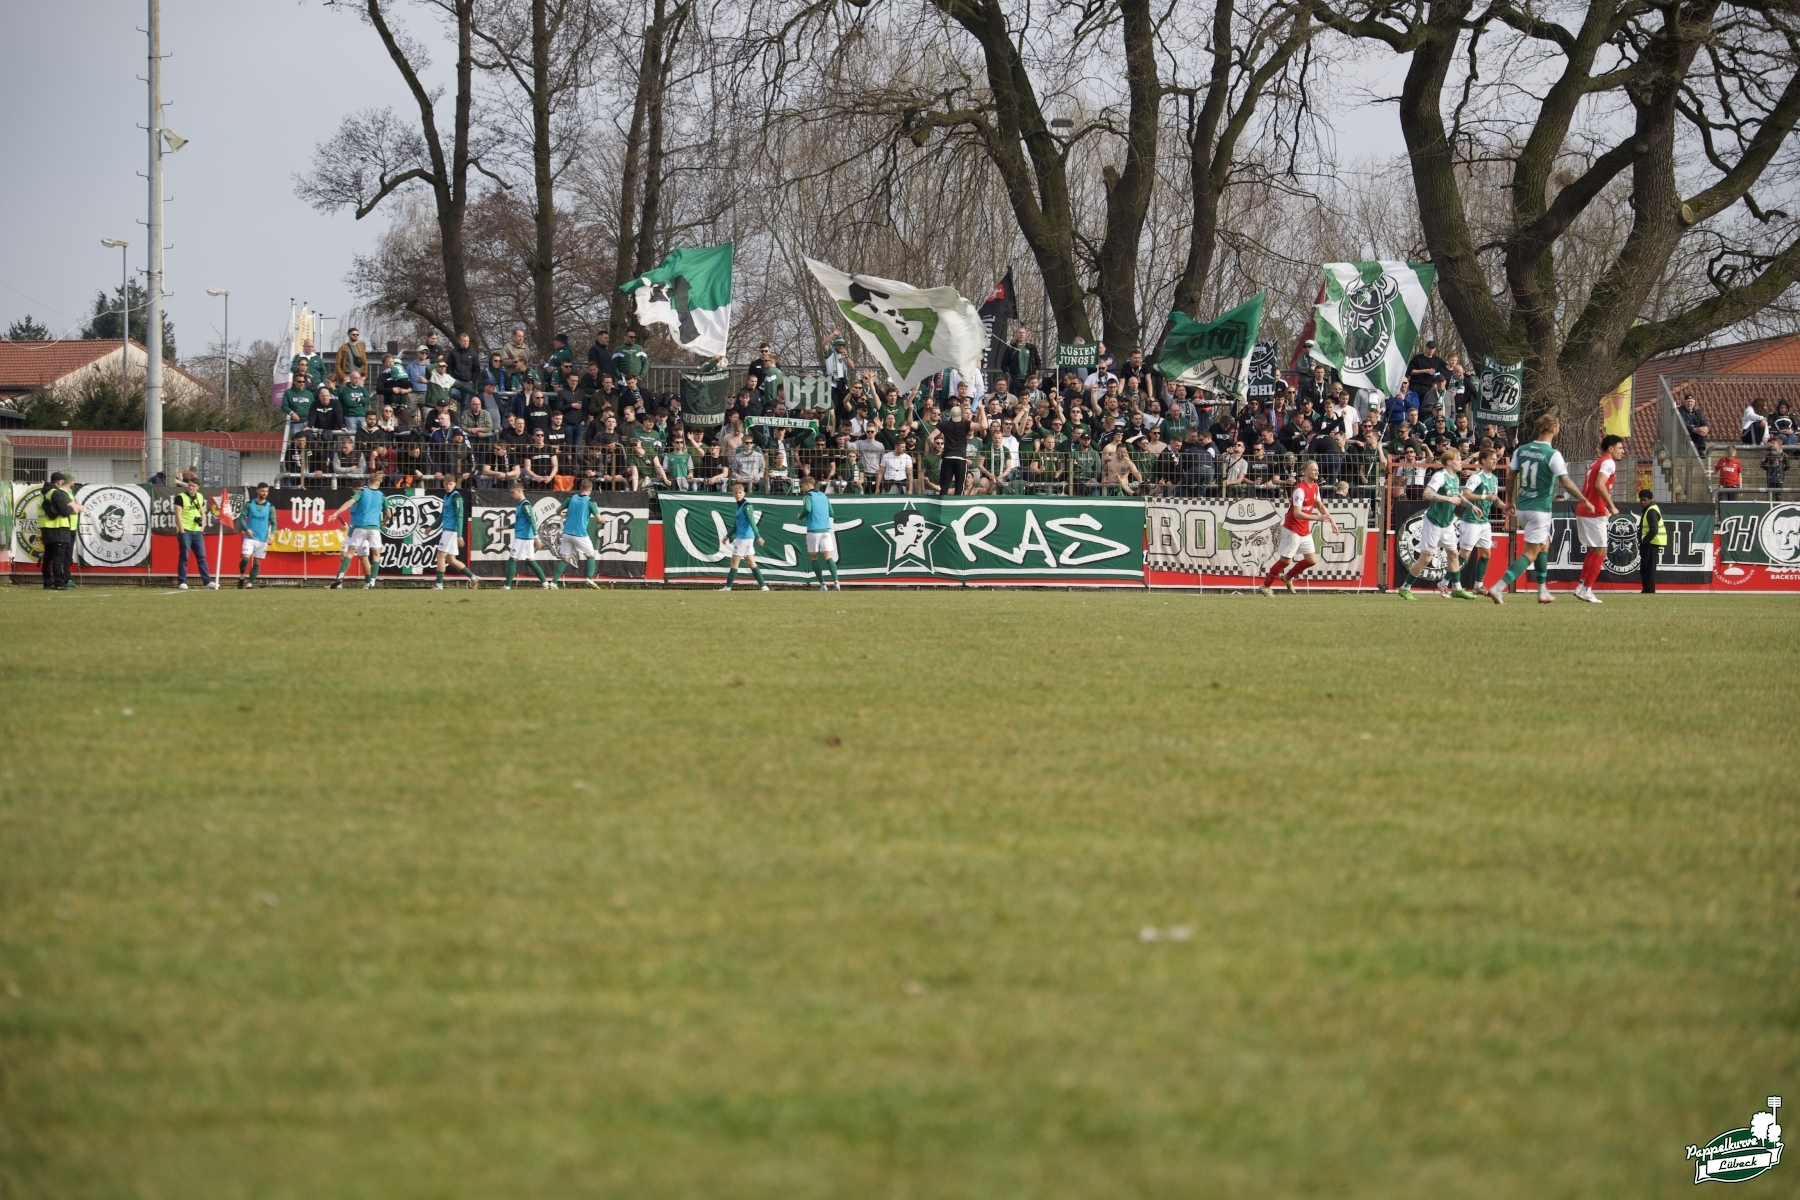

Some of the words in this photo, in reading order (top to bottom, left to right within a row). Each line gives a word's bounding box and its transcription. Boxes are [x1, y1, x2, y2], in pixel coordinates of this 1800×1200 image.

[1059, 355, 1089, 366] JUNGS
[1060, 345, 1097, 356] KÜSTEN
[783, 374, 833, 411] VfB
[1249, 383, 1276, 397] BHL
[1492, 379, 1519, 406] VfB
[1520, 459, 1539, 489] 11
[83, 492, 143, 519] KÜSTENJUNGS
[289, 496, 326, 529] VfB
[135, 526, 144, 534] 19
[1720, 514, 1760, 552] H
[88, 540, 138, 559] LÜBECK
